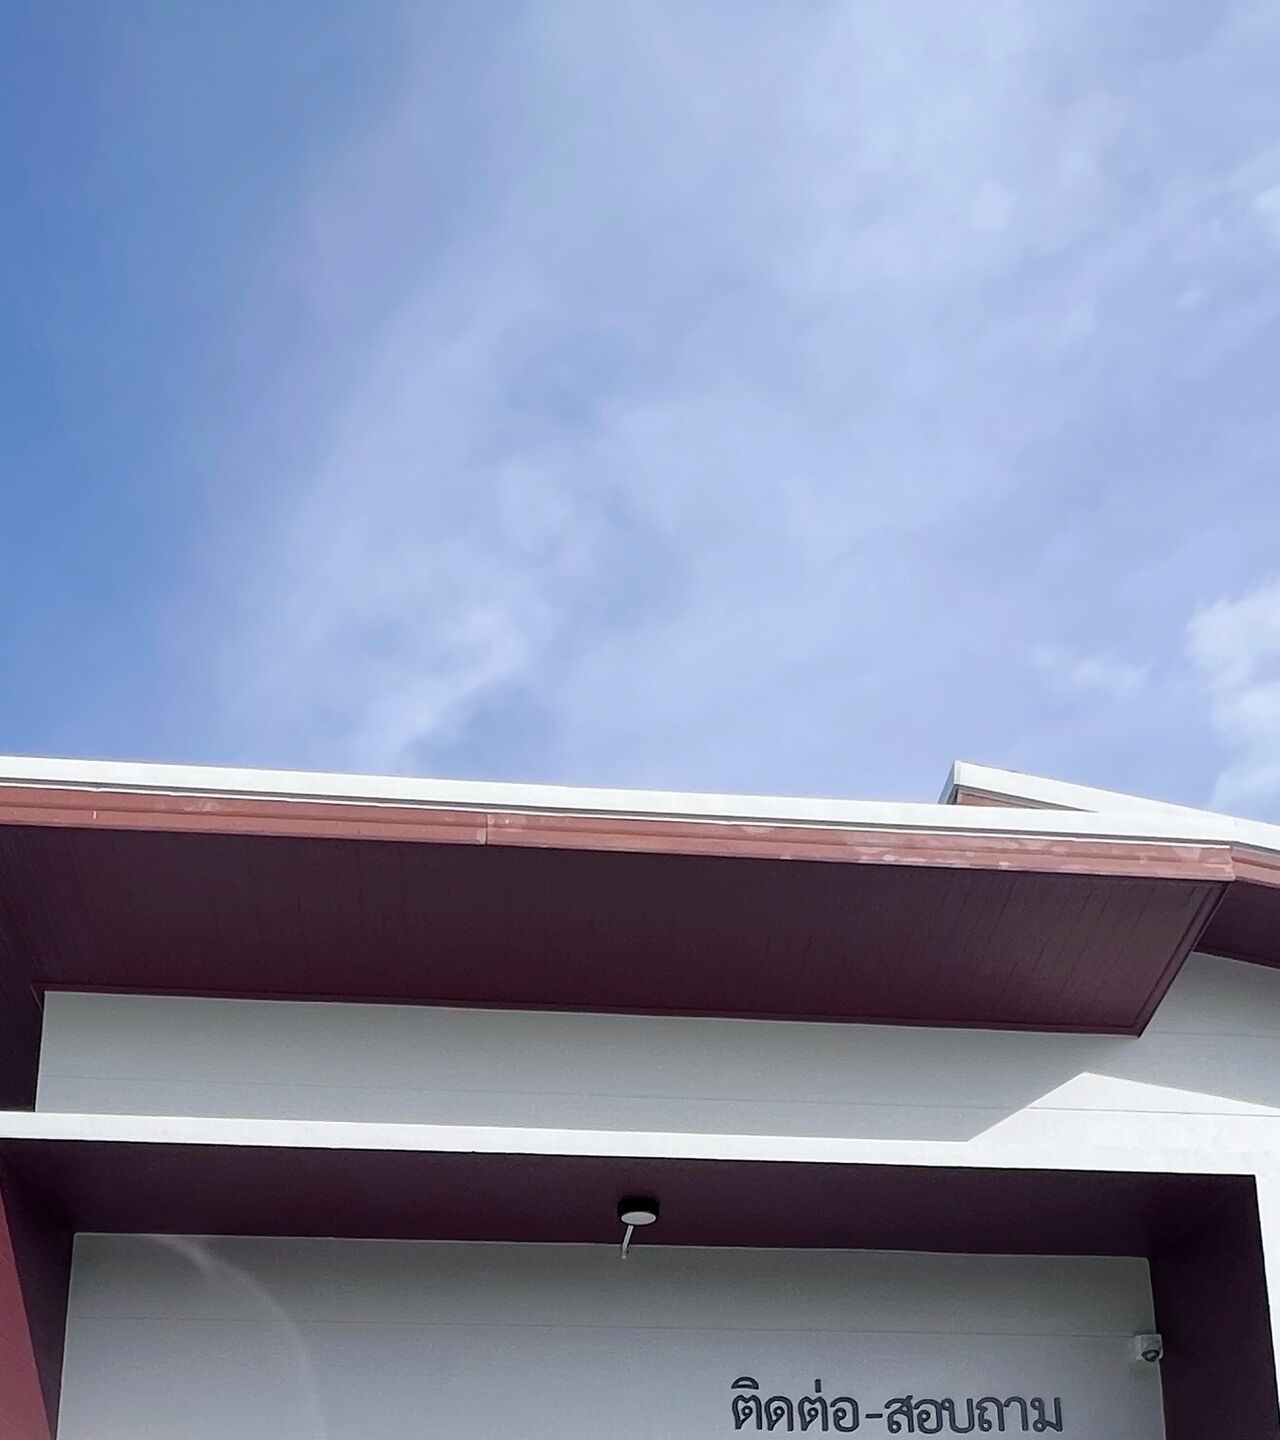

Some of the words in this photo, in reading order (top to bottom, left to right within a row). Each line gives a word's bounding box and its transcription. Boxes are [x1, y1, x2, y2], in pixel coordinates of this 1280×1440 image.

[730, 1376, 1063, 1434] ติดต่อ-สอบถาม
